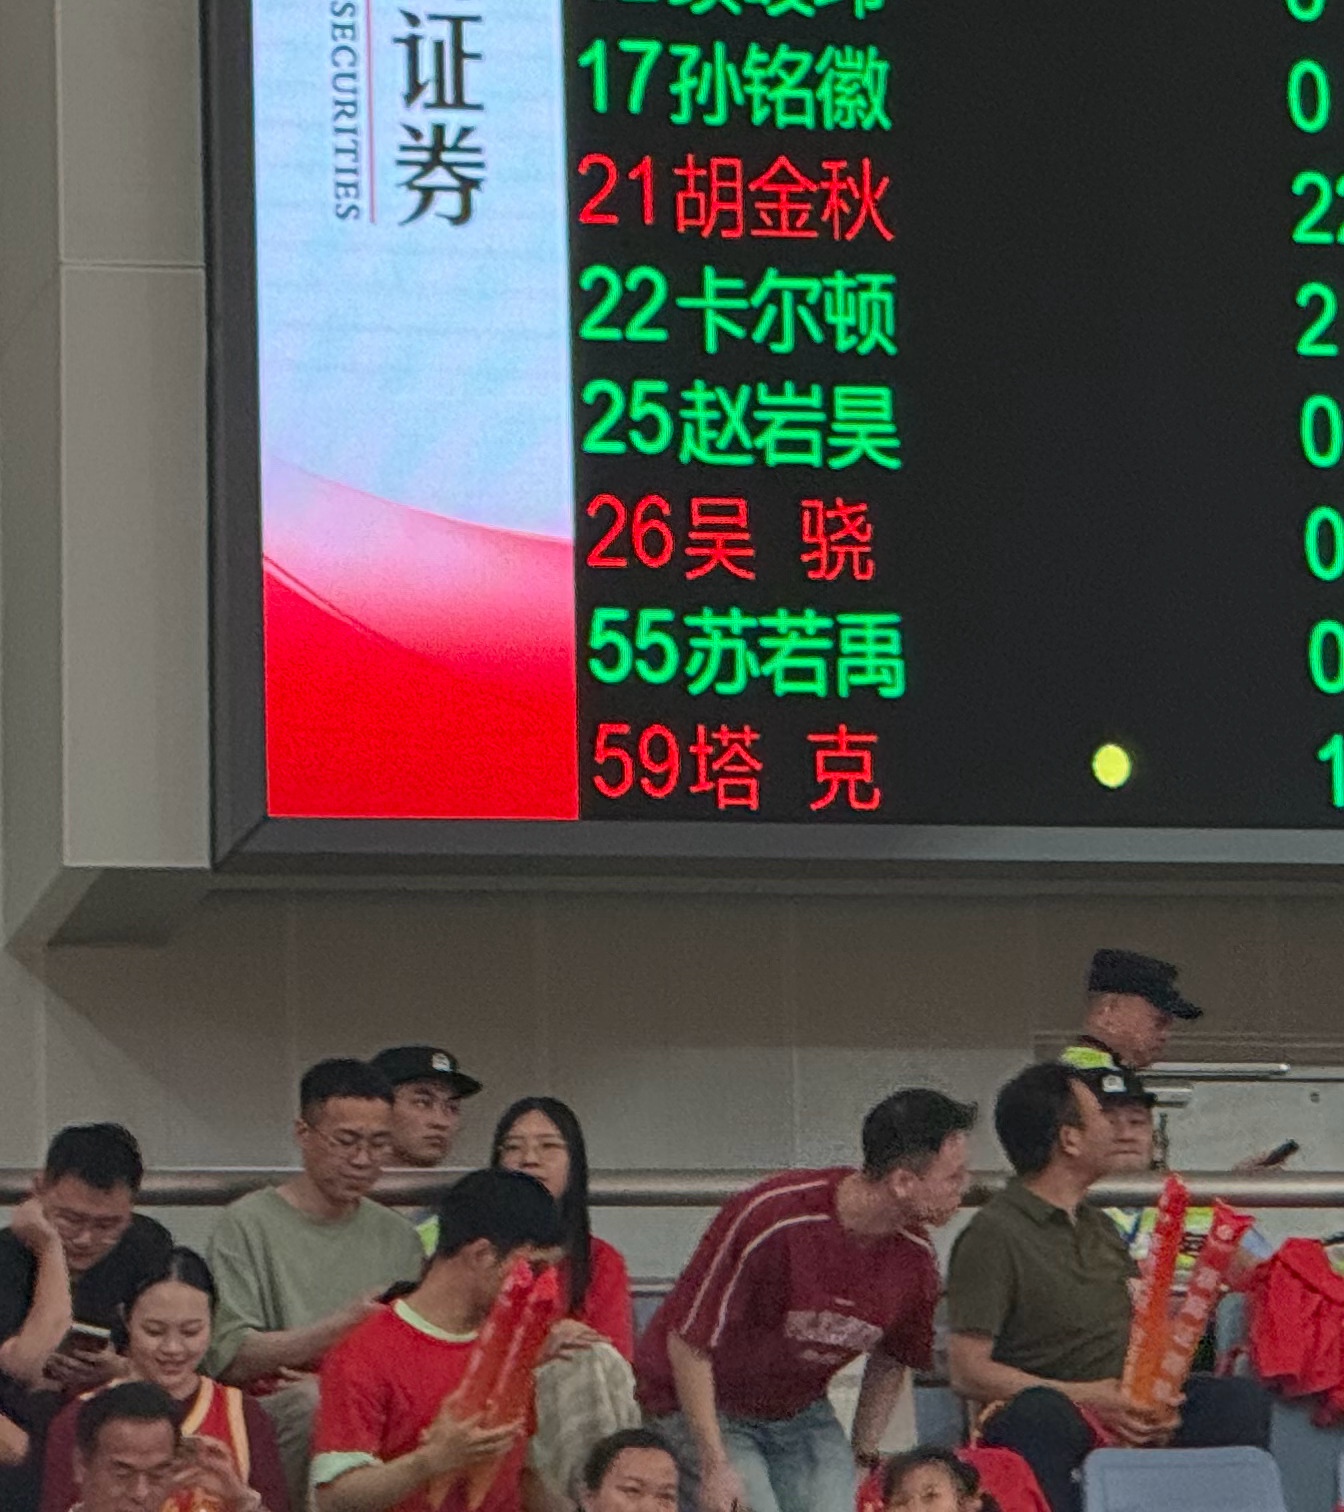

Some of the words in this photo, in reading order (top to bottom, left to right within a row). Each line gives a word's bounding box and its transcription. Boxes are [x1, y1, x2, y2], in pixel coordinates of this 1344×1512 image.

[330, 0, 361, 221] SECURITIES
[1288, 59, 1330, 132] 0
[1296, 282, 1338, 356] 2
[1300, 395, 1343, 467] 0
